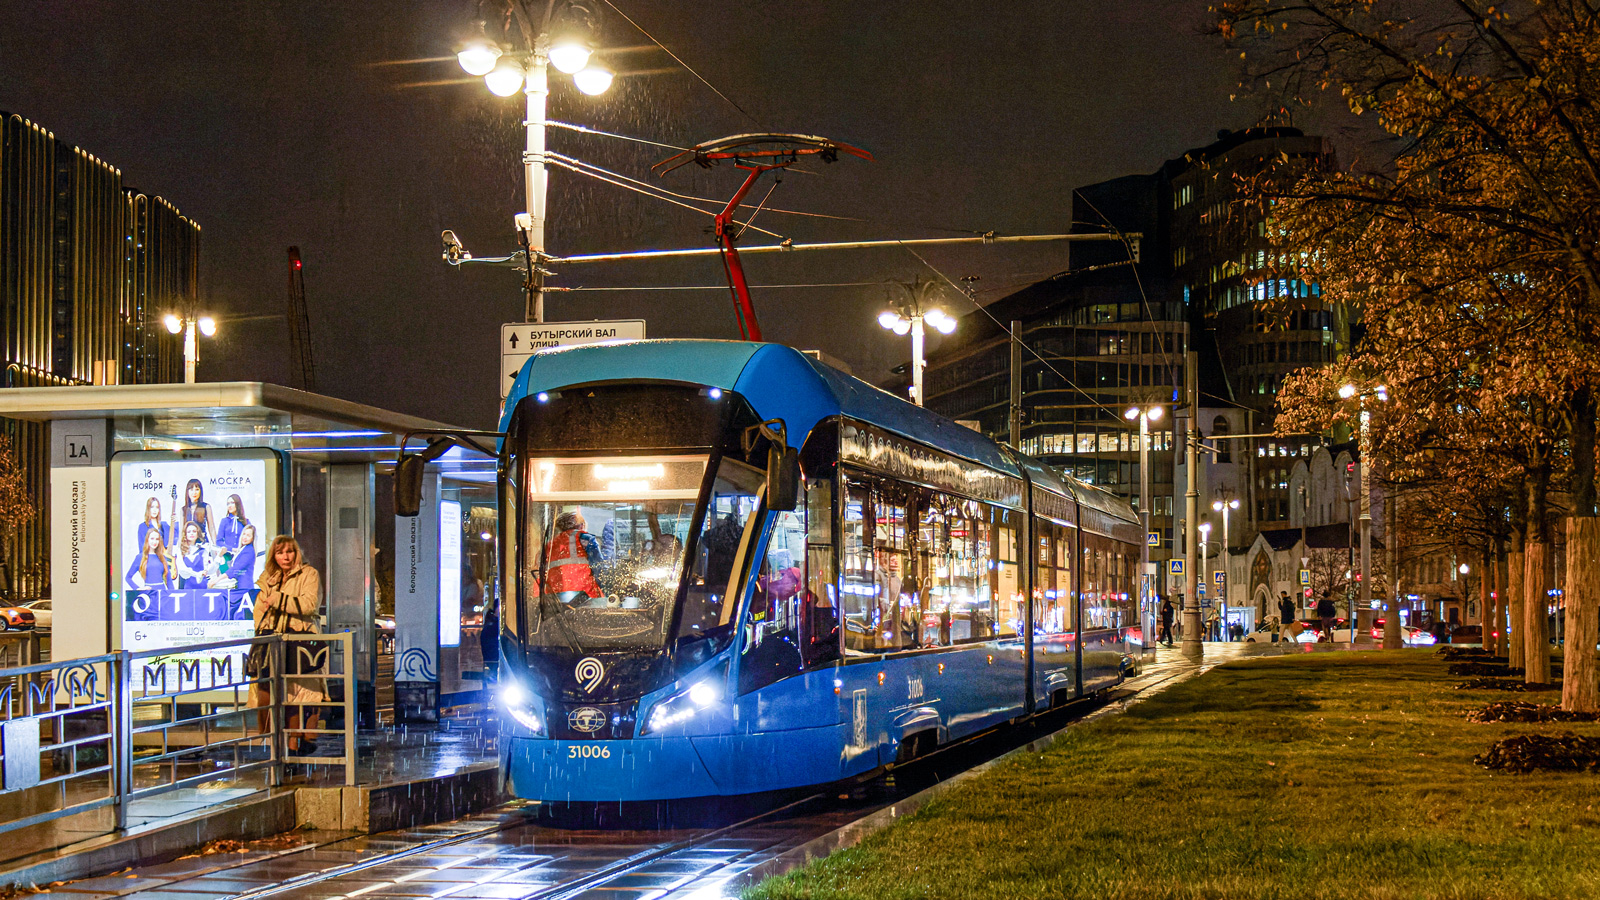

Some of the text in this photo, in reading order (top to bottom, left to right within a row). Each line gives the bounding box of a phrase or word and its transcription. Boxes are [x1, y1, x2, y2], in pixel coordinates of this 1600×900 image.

[530, 328, 616, 340] БУТЫРСКИЙ ВАЛ
[530, 340, 560, 350] улица
[143, 468, 152, 478] 18
[132, 480, 163, 491] ноября
[69, 480, 81, 584] Белорусский вокзал
[408, 545, 418, 594] Белорусский
[134, 631, 148, 641] 6+
[186, 627, 205, 636] ШОУ
[567, 745, 611, 759] 31006
